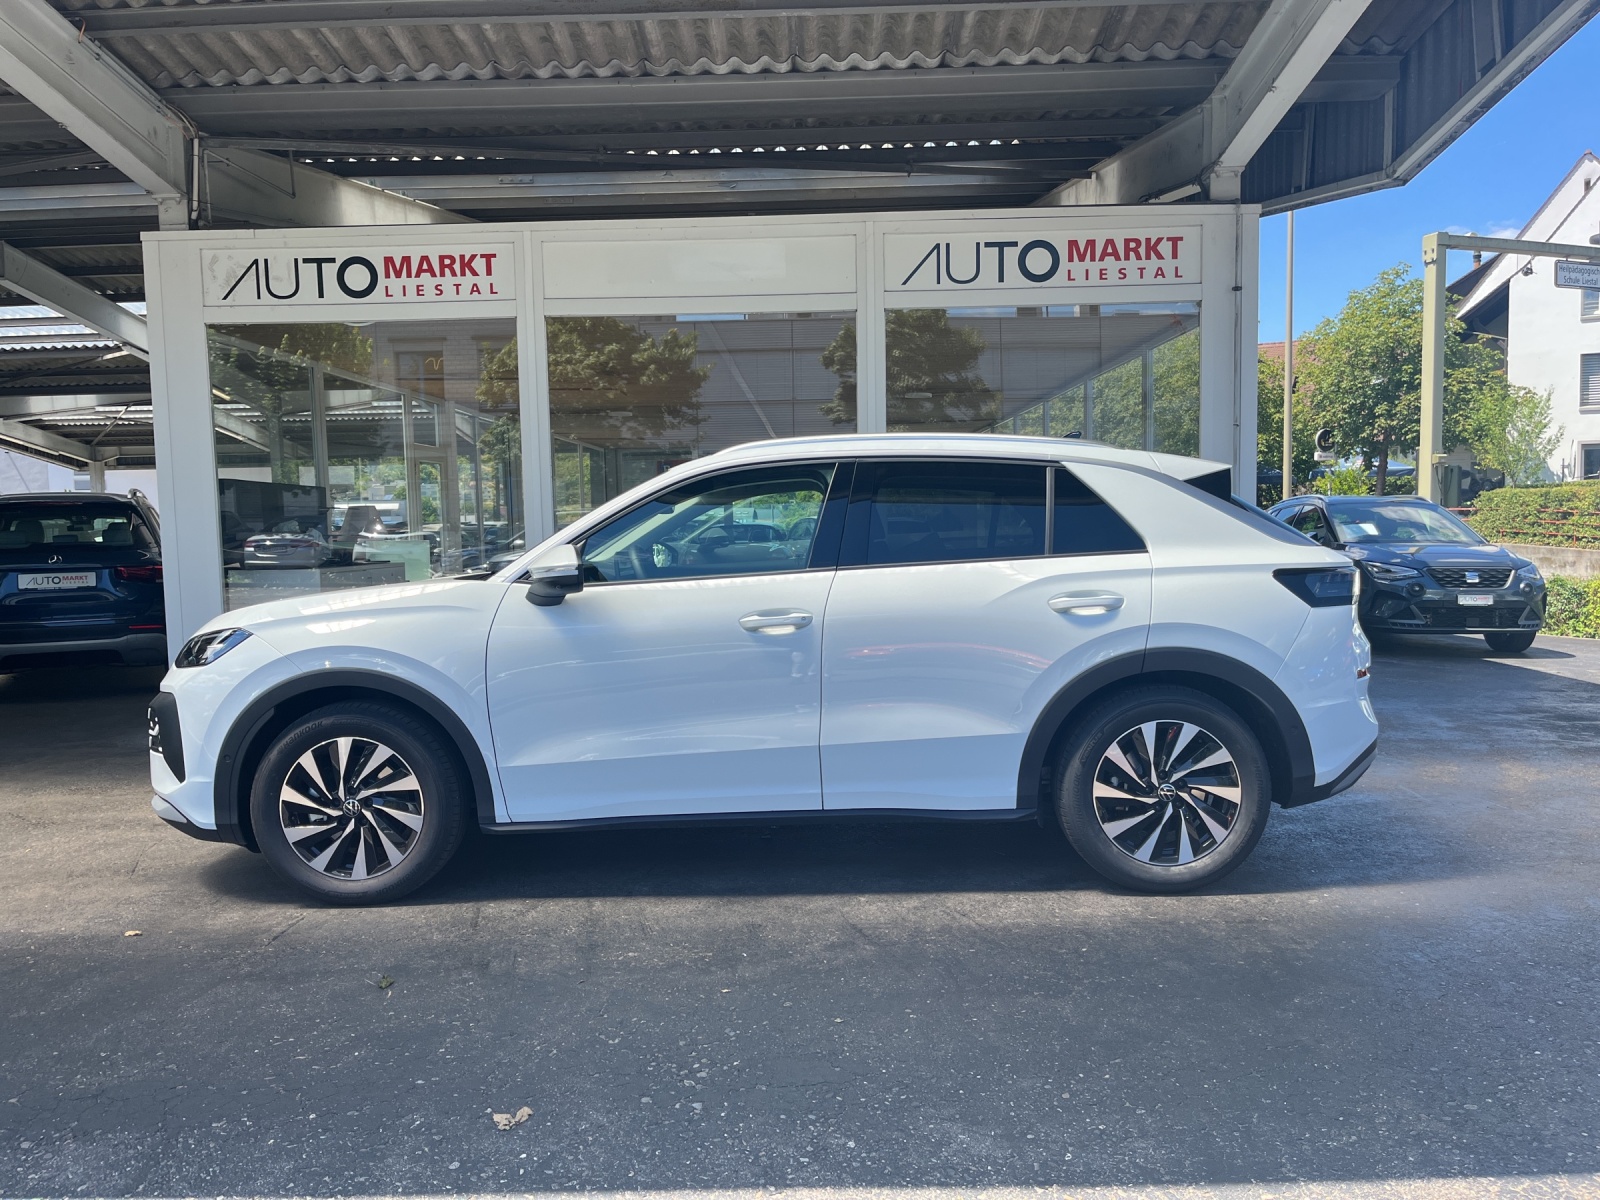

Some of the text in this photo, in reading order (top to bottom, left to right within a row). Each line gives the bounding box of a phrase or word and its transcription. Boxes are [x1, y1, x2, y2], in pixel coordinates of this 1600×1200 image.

[901, 236, 1184, 285] AUTO MARKT
[222, 253, 497, 300] AUTO MARKT
[1067, 266, 1183, 281] LIESTAL
[1564, 276, 1580, 284] Schule
[385, 283, 499, 298] LIESTAL
[26, 576, 62, 586] AUTO
